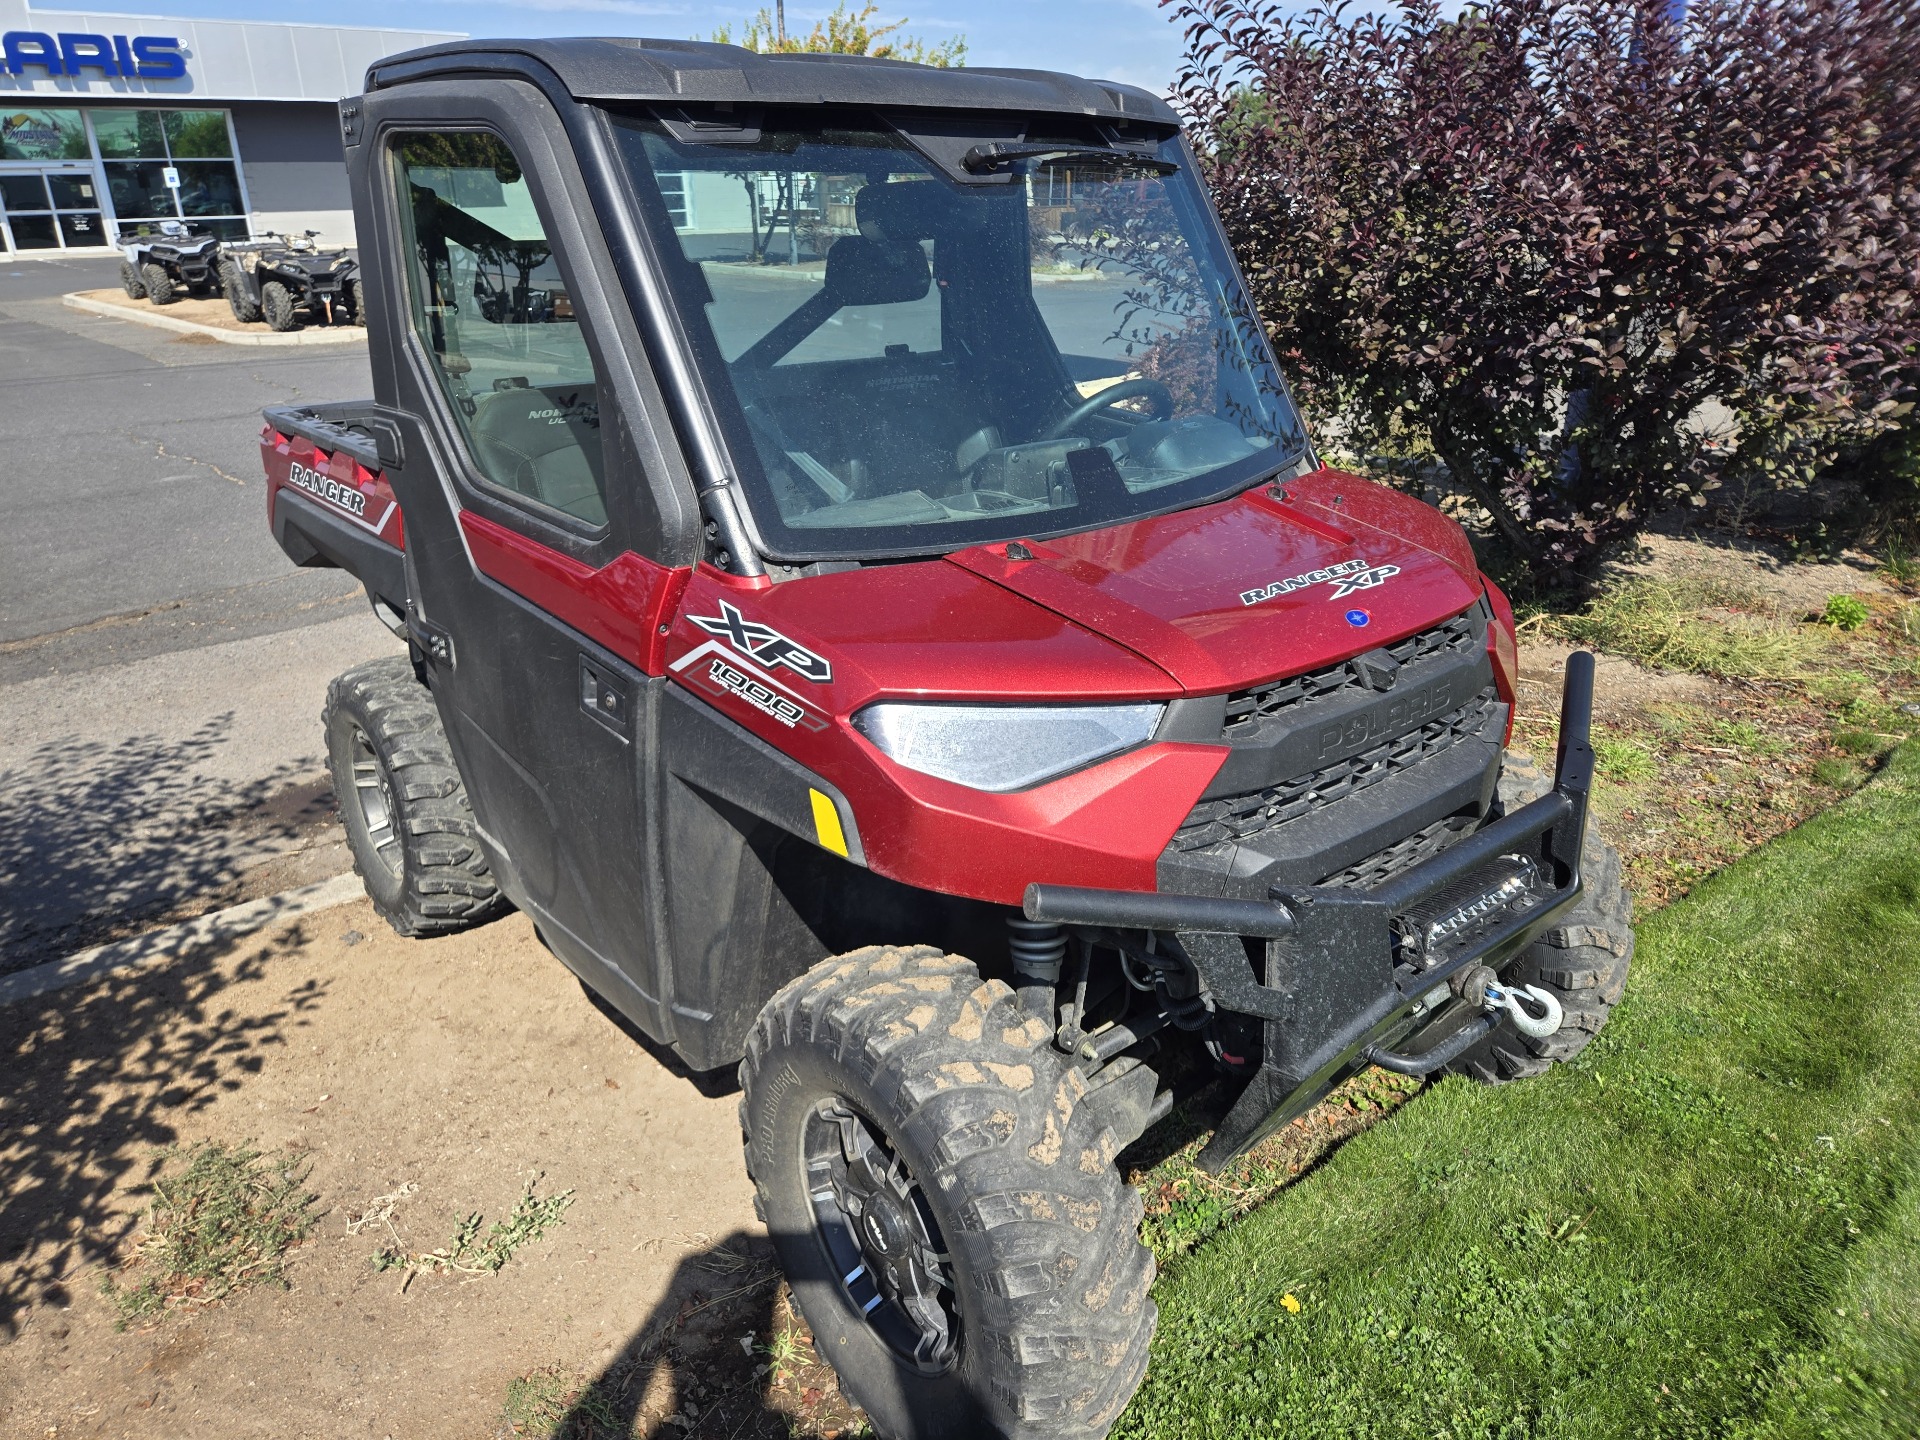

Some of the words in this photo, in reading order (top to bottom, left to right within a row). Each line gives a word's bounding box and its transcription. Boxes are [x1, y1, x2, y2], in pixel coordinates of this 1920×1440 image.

[0, 31, 187, 79] ARIS
[290, 462, 366, 516] RANGER
[1239, 559, 1369, 606] RANGER
[1328, 564, 1401, 600] XP
[683, 598, 834, 684] XP
[708, 658, 805, 723] 1000
[709, 674, 730, 690] DUAL
[730, 687, 776, 716] OVERHEAD
[774, 713, 796, 729] CAM
[1317, 684, 1451, 760] POLARIS
